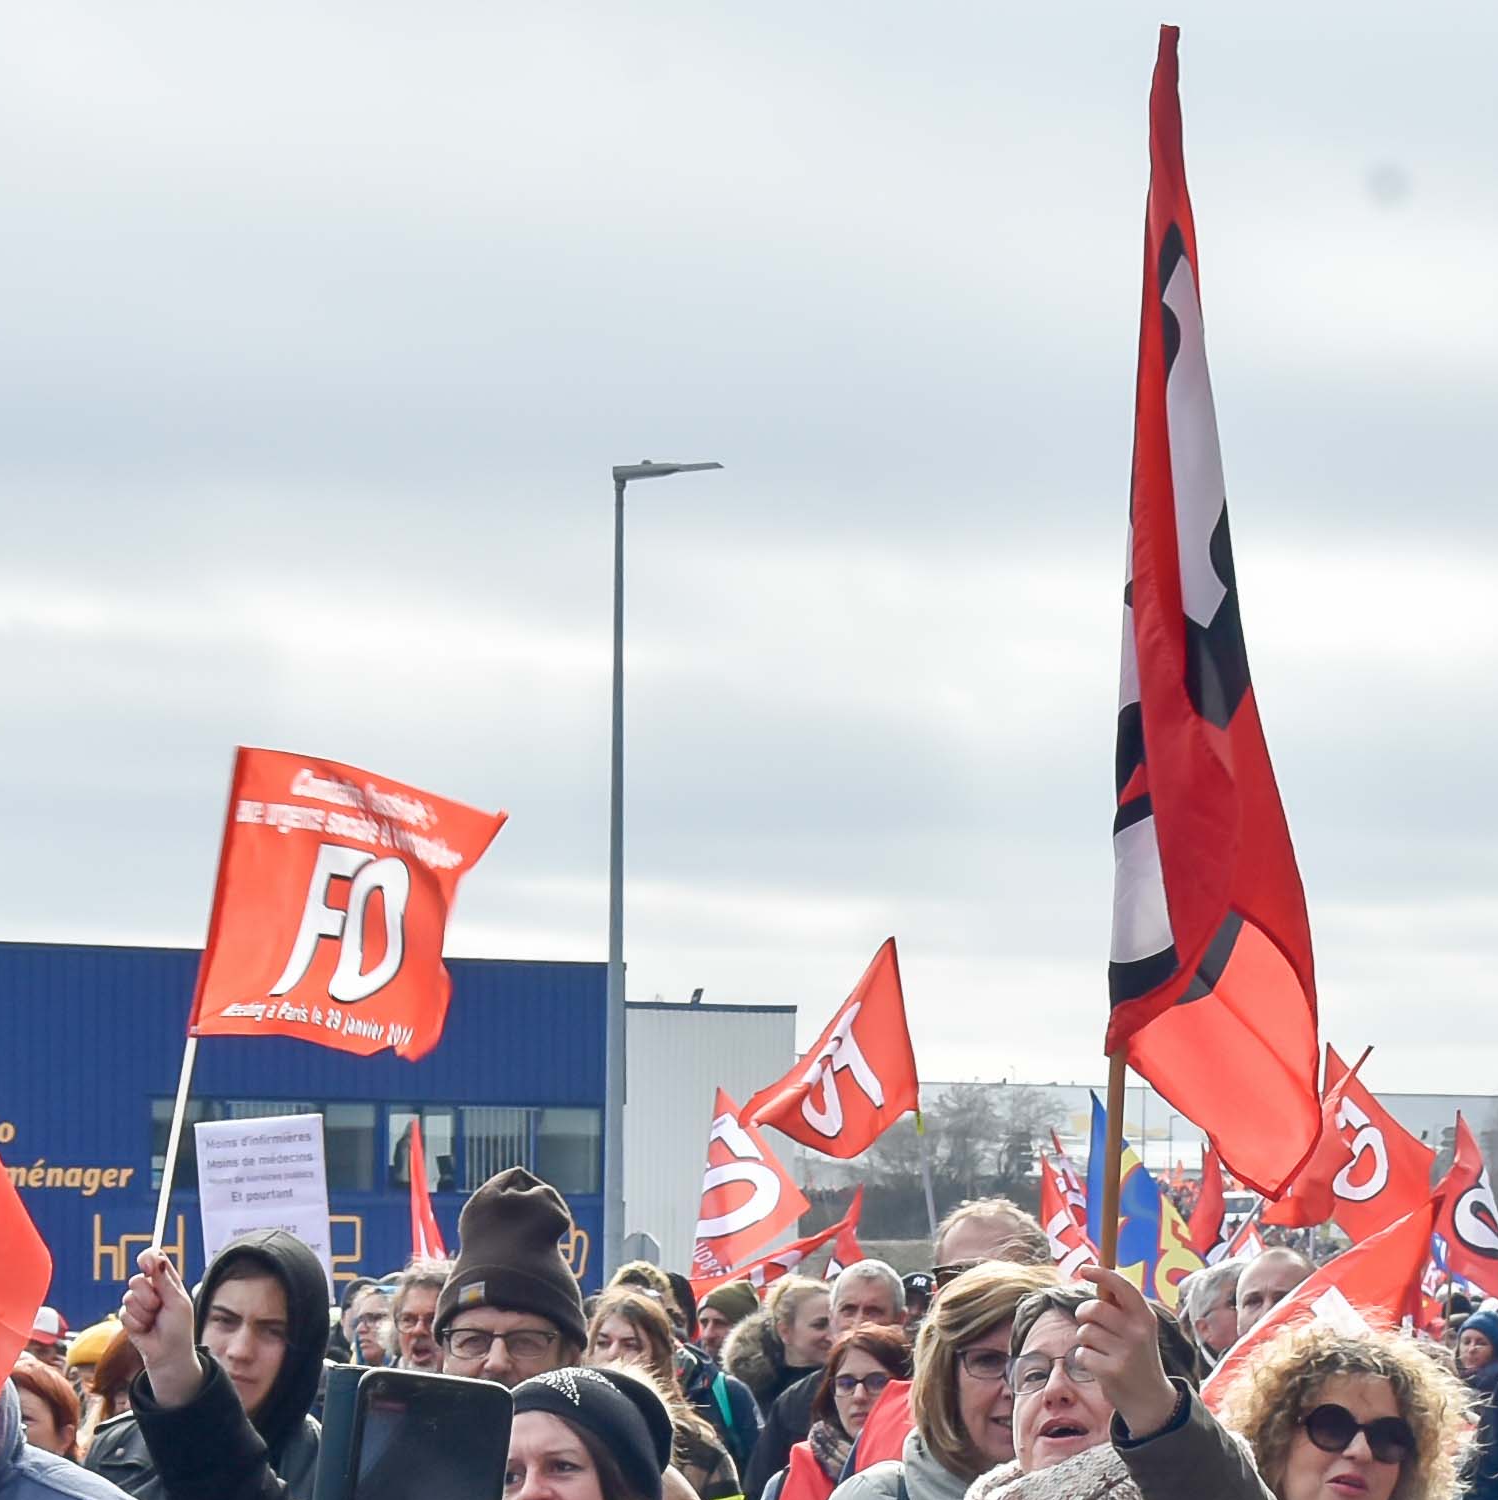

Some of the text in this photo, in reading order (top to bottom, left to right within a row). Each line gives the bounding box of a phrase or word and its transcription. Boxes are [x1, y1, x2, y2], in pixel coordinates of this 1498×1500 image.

[268, 843, 410, 1003] FO
[277, 1001, 309, 1023] Paris
[325, 1008, 341, 1030] 29
[342, 1012, 385, 1041] janvier
[242, 1156, 255, 1167] de
[231, 1188, 293, 1204] Et pourtant
